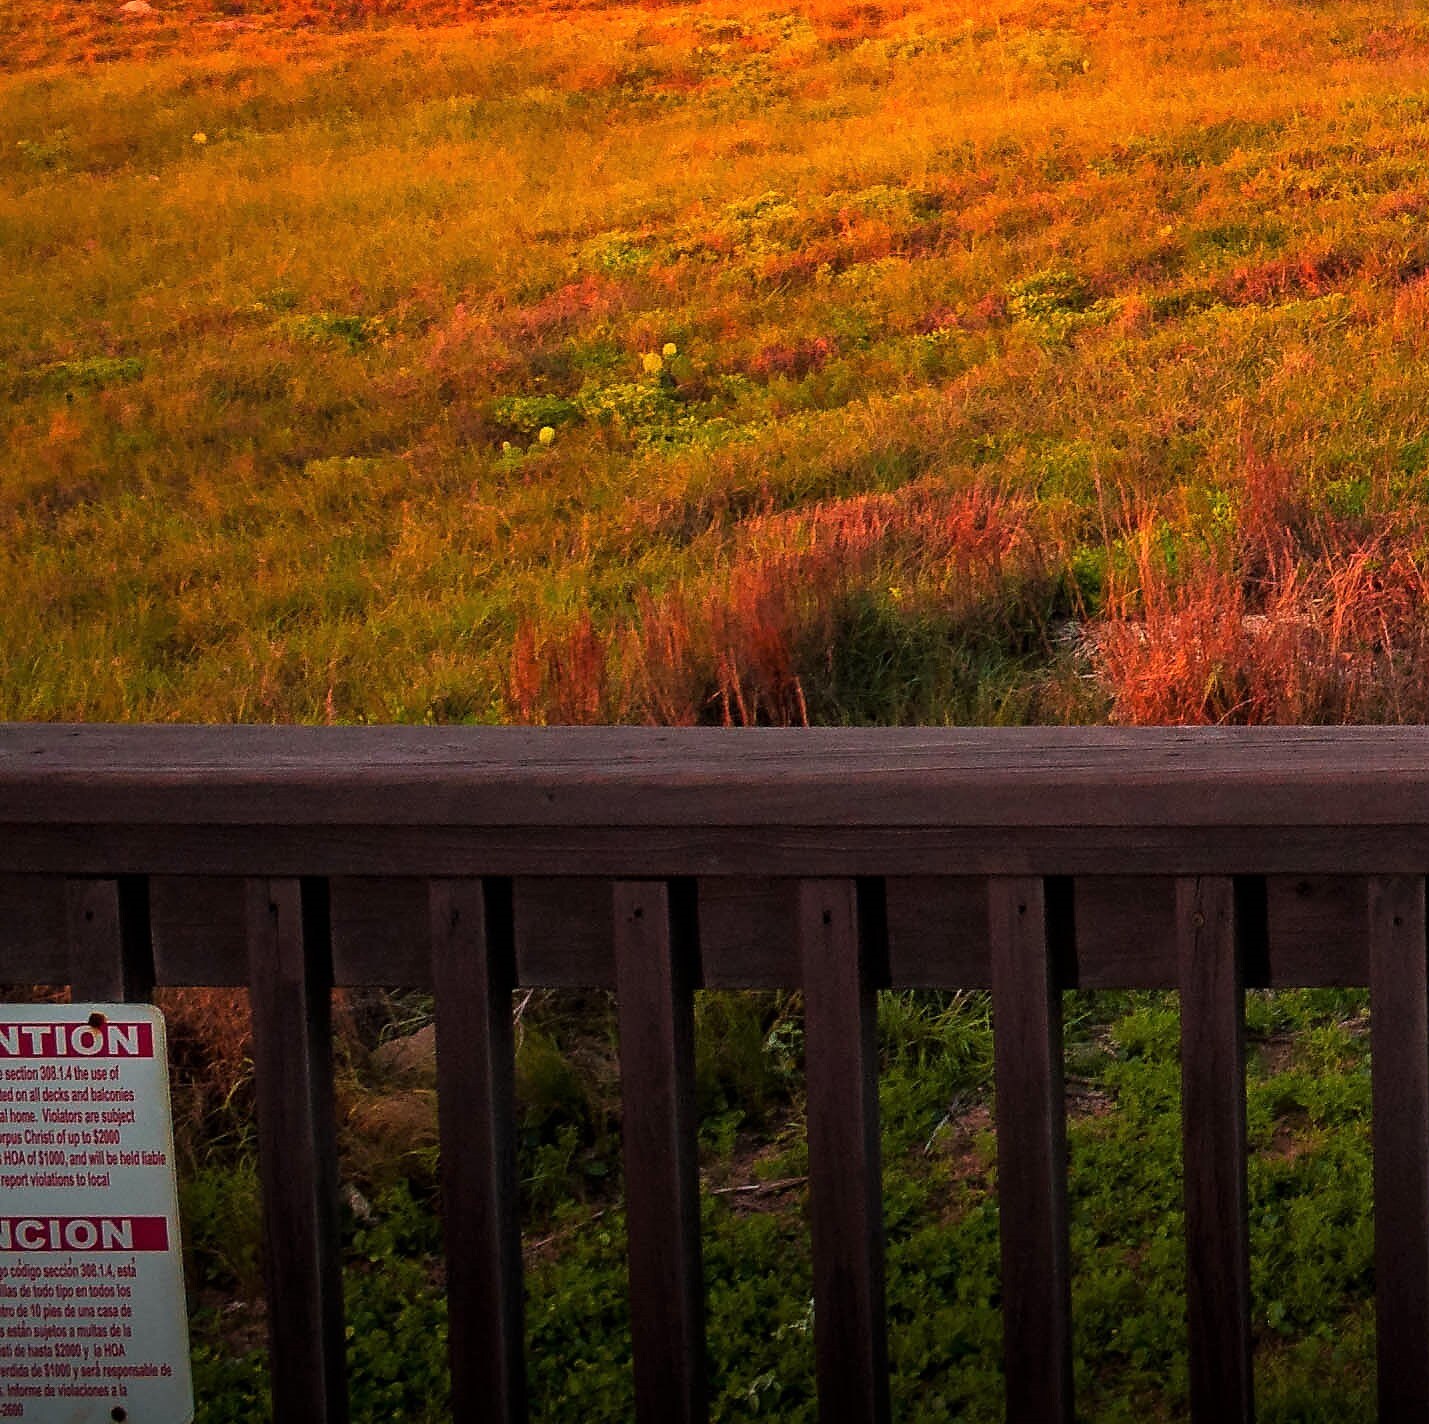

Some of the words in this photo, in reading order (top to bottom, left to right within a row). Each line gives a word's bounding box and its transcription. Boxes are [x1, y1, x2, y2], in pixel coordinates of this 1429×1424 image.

[5, 1066, 38, 1080] section
[40, 1066, 72, 1080] 308.1.4
[74, 1066, 89, 1080] the
[91, 1069, 107, 1080] use
[110, 1066, 119, 1080] of
[16, 1091, 27, 1102] on
[30, 1088, 40, 1102] all
[42, 1088, 70, 1102] decks
[72, 1088, 88, 1102] and
[91, 1088, 134, 1102] balconies
[10, 1109, 38, 1123] home.
[42, 1109, 82, 1123] Violators
[85, 1112, 99, 1123] are
[102, 1109, 135, 1126] subject
[24, 1130, 55, 1144] Christi
[57, 1130, 66, 1144] of
[70, 1133, 79, 1146] up
[82, 1130, 90, 1144] to
[93, 1130, 120, 1144] $2000
[4, 1151, 25, 1165] HOA
[27, 1151, 37, 1165] of
[38, 1151, 68, 1166] $1000,
[70, 1151, 86, 1165] and
[89, 1151, 104, 1165] will
[107, 1151, 118, 1165] be
[120, 1151, 139, 1165] held
[142, 1151, 166, 1165] liable
[1, 1173, 28, 1188] report
[31, 1173, 74, 1186] violations
[77, 1173, 85, 1186] to
[88, 1173, 110, 1186] local
[20, 1284, 31, 1297] de
[33, 1284, 53, 1297] todo
[56, 1284, 73, 1300] tipo
[76, 1287, 87, 1297] en
[89, 1284, 114, 1297] todos
[116, 1284, 131, 1297] los
[17, 1304, 28, 1317] de
[30, 1304, 41, 1317] 10
[43, 1304, 62, 1320] pies
[64, 1304, 75, 1317] de
[78, 1307, 95, 1317] una
[97, 1307, 118, 1317] casa
[120, 1304, 132, 1317] de
[34, 1324, 67, 1341] sujetos
[69, 1327, 75, 1337] a
[77, 1324, 108, 1337] multas
[110, 1324, 121, 1337] de
[123, 1324, 132, 1337] la
[14, 1343, 25, 1357] de
[28, 1343, 53, 1357] hasta
[55, 1343, 82, 1357] $2000
[83, 1347, 89, 1360] y
[94, 1343, 102, 1357] la
[104, 1343, 126, 1357] HOA
[31, 1364, 42, 1377] de
[44, 1364, 71, 1377] $1000
[72, 1367, 78, 1380] y
[103, 1364, 157, 1379] responsable
[160, 1364, 171, 1377] de
[44, 1384, 55, 1396] de
[58, 1384, 109, 1396] violaciones
